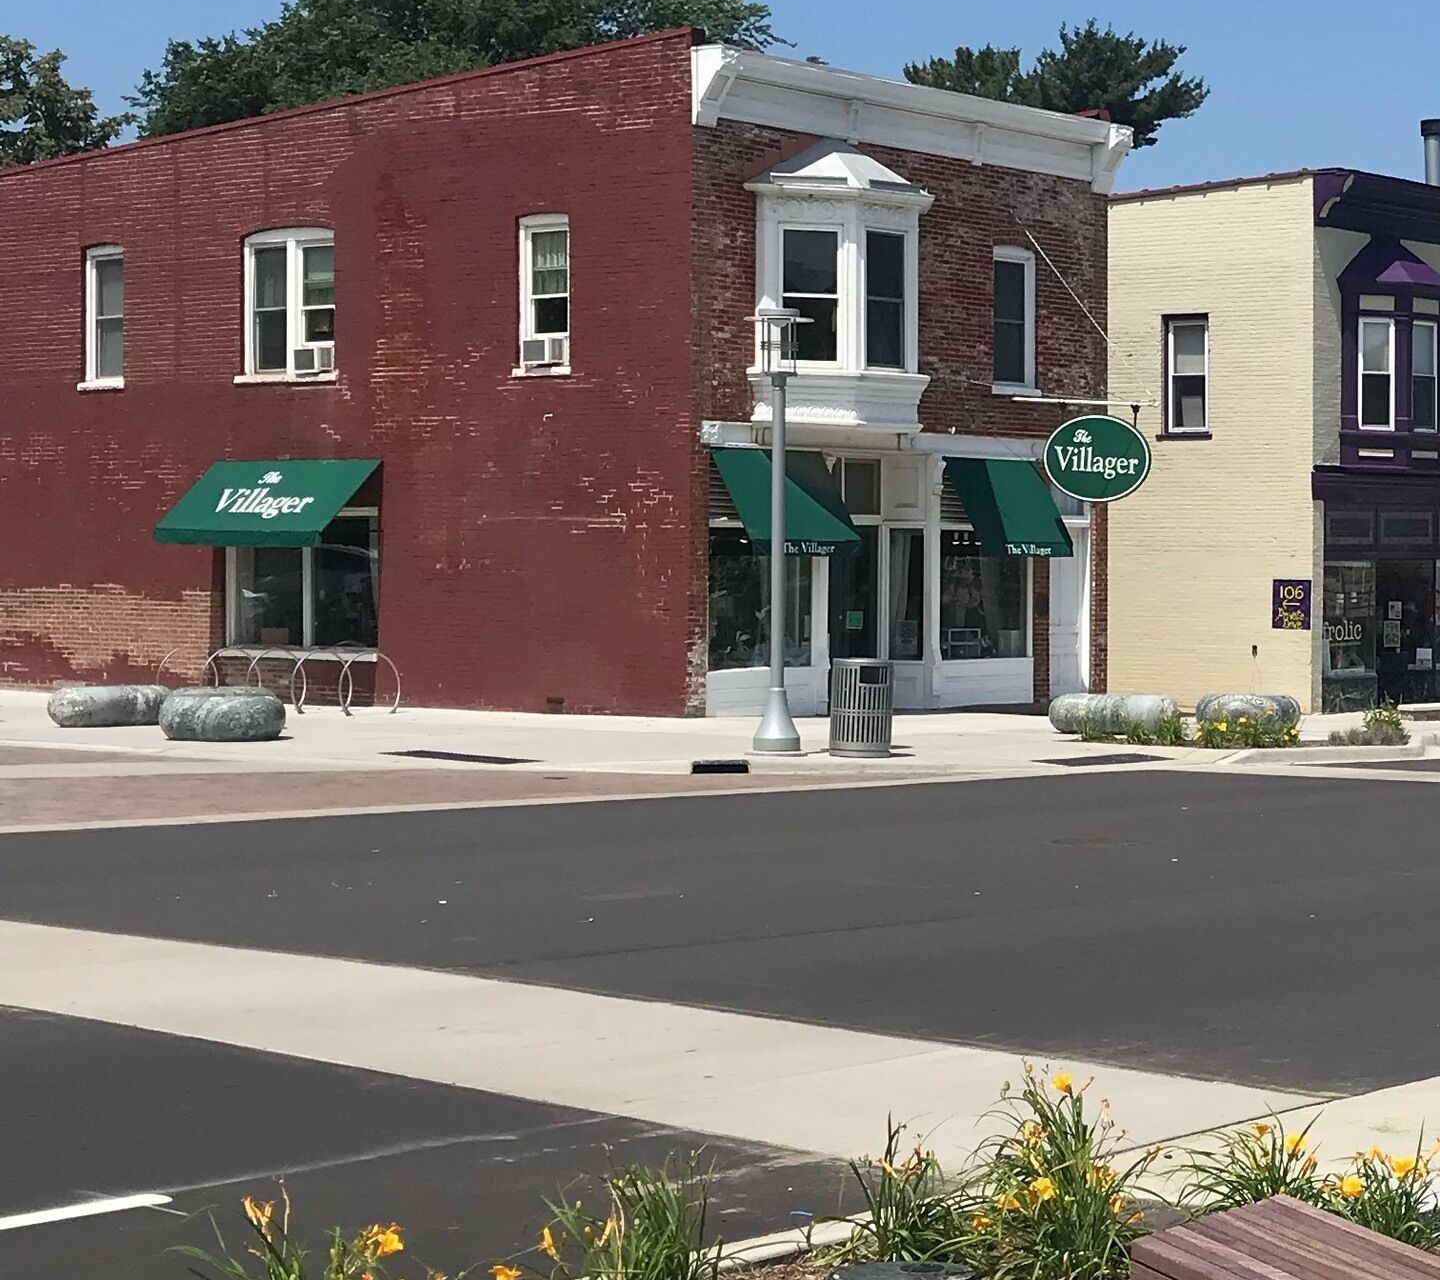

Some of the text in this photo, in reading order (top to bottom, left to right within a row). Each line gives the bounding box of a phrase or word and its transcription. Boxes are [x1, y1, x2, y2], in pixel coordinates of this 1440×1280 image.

[1073, 428, 1093, 444] The
[1053, 445, 1139, 480] Villager
[257, 471, 283, 485] The
[215, 487, 315, 519] Villager
[783, 541, 836, 555] The Villager
[1005, 543, 1052, 556] The Villager
[1279, 585, 1305, 600] 106
[1323, 620, 1363, 641] frolic
